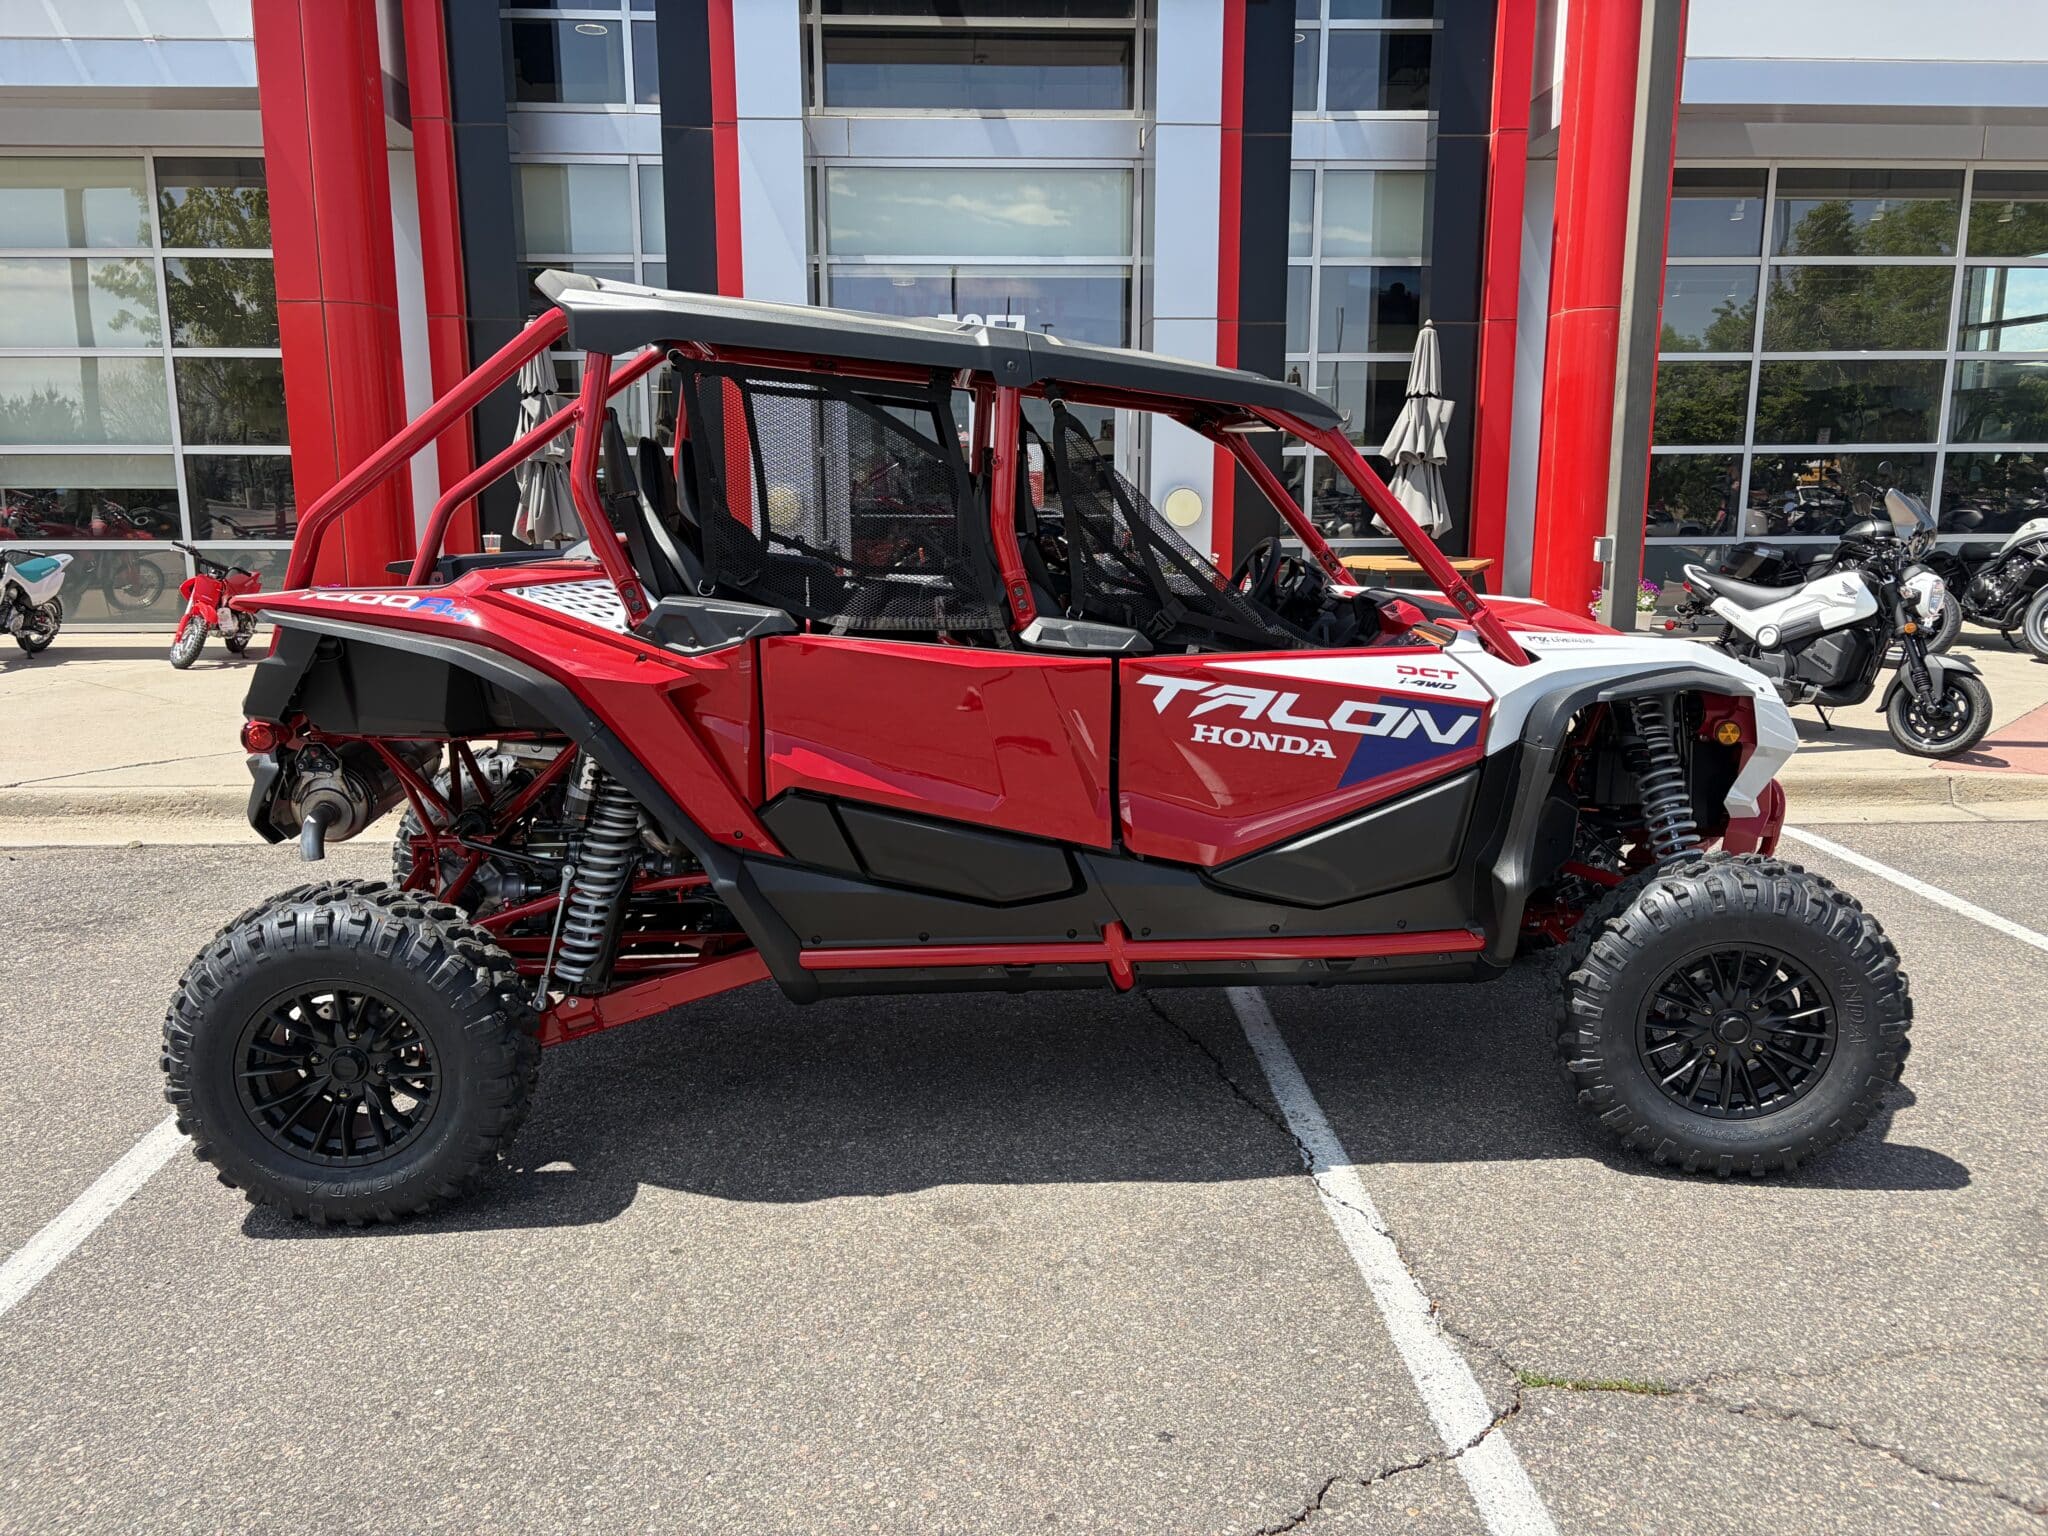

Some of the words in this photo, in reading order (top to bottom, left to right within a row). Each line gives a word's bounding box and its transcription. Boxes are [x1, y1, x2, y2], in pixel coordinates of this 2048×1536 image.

[1396, 664, 1459, 680] DCT
[1136, 674, 1479, 745] TALON
[1190, 723, 1336, 759] HONDA
